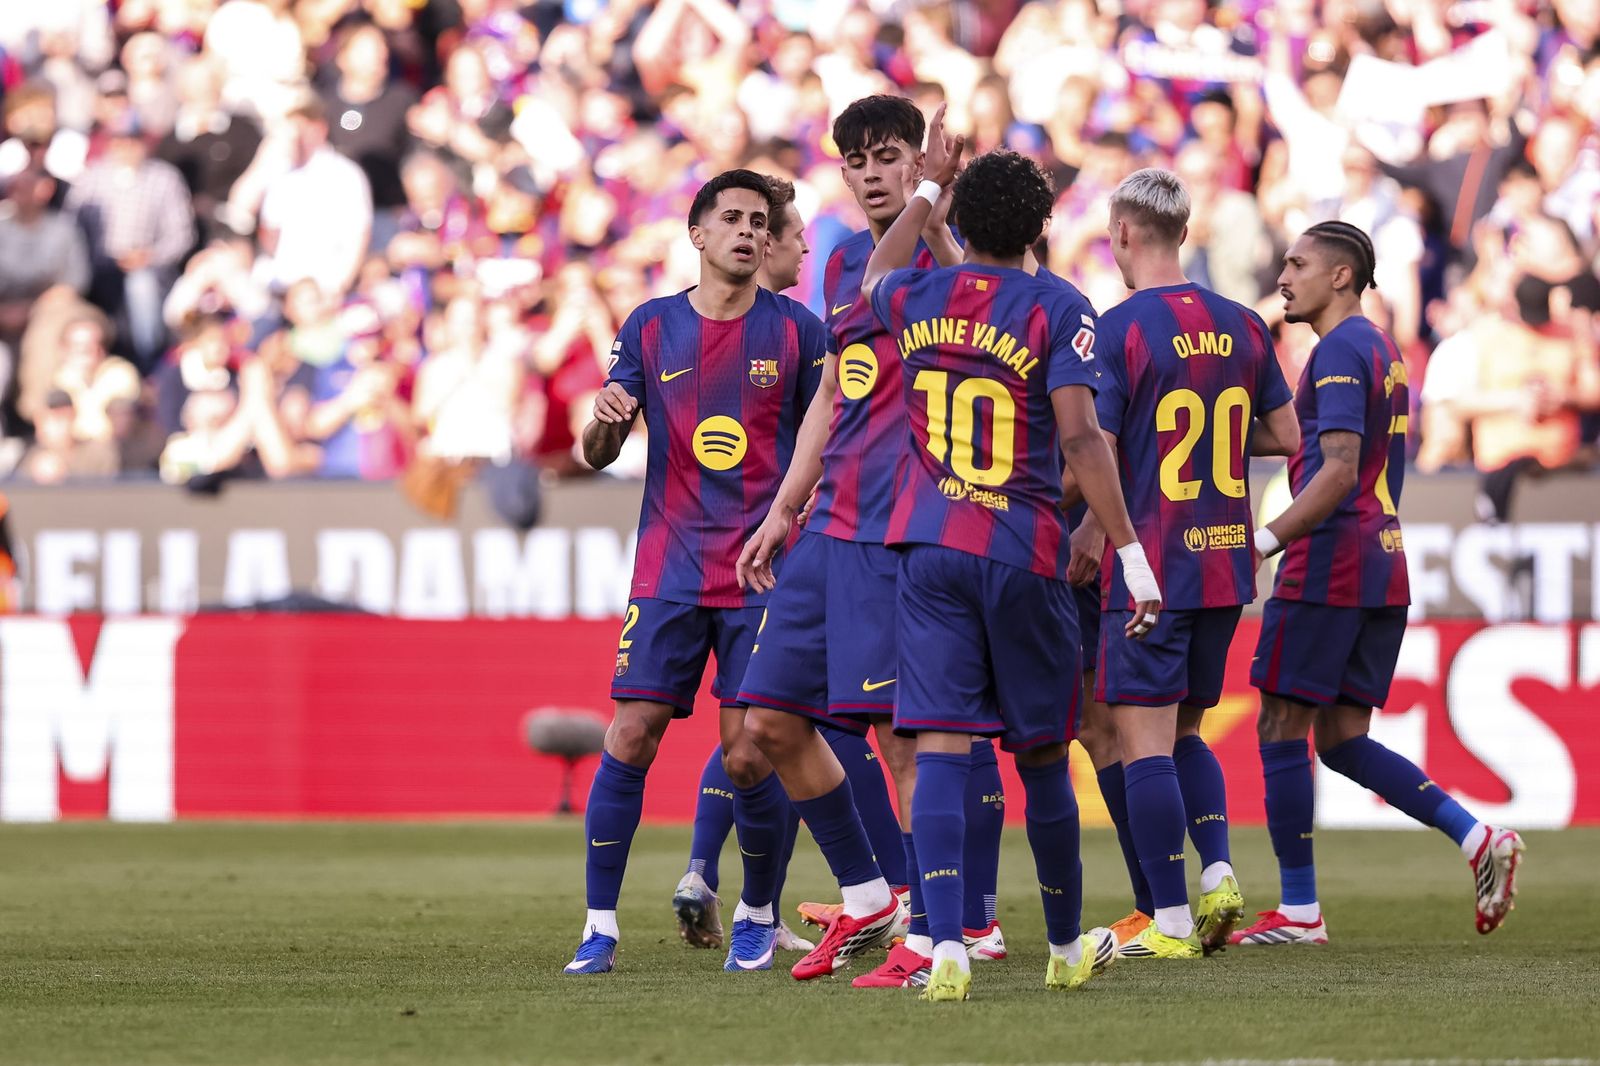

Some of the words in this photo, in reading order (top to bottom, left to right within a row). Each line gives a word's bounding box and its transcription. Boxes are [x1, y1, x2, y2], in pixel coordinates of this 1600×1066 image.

[897, 317, 968, 360] LAMINE
[971, 321, 1040, 380] YAMAL
[1172, 331, 1233, 359] OLMO
[913, 369, 1016, 487] 10
[1155, 386, 1251, 502] 20
[1206, 523, 1246, 537] UNHCR
[1208, 533, 1247, 547] ACNUR
[18, 527, 293, 617] ELLA
[1401, 522, 1600, 624] EST
[619, 604, 640, 649] 2
